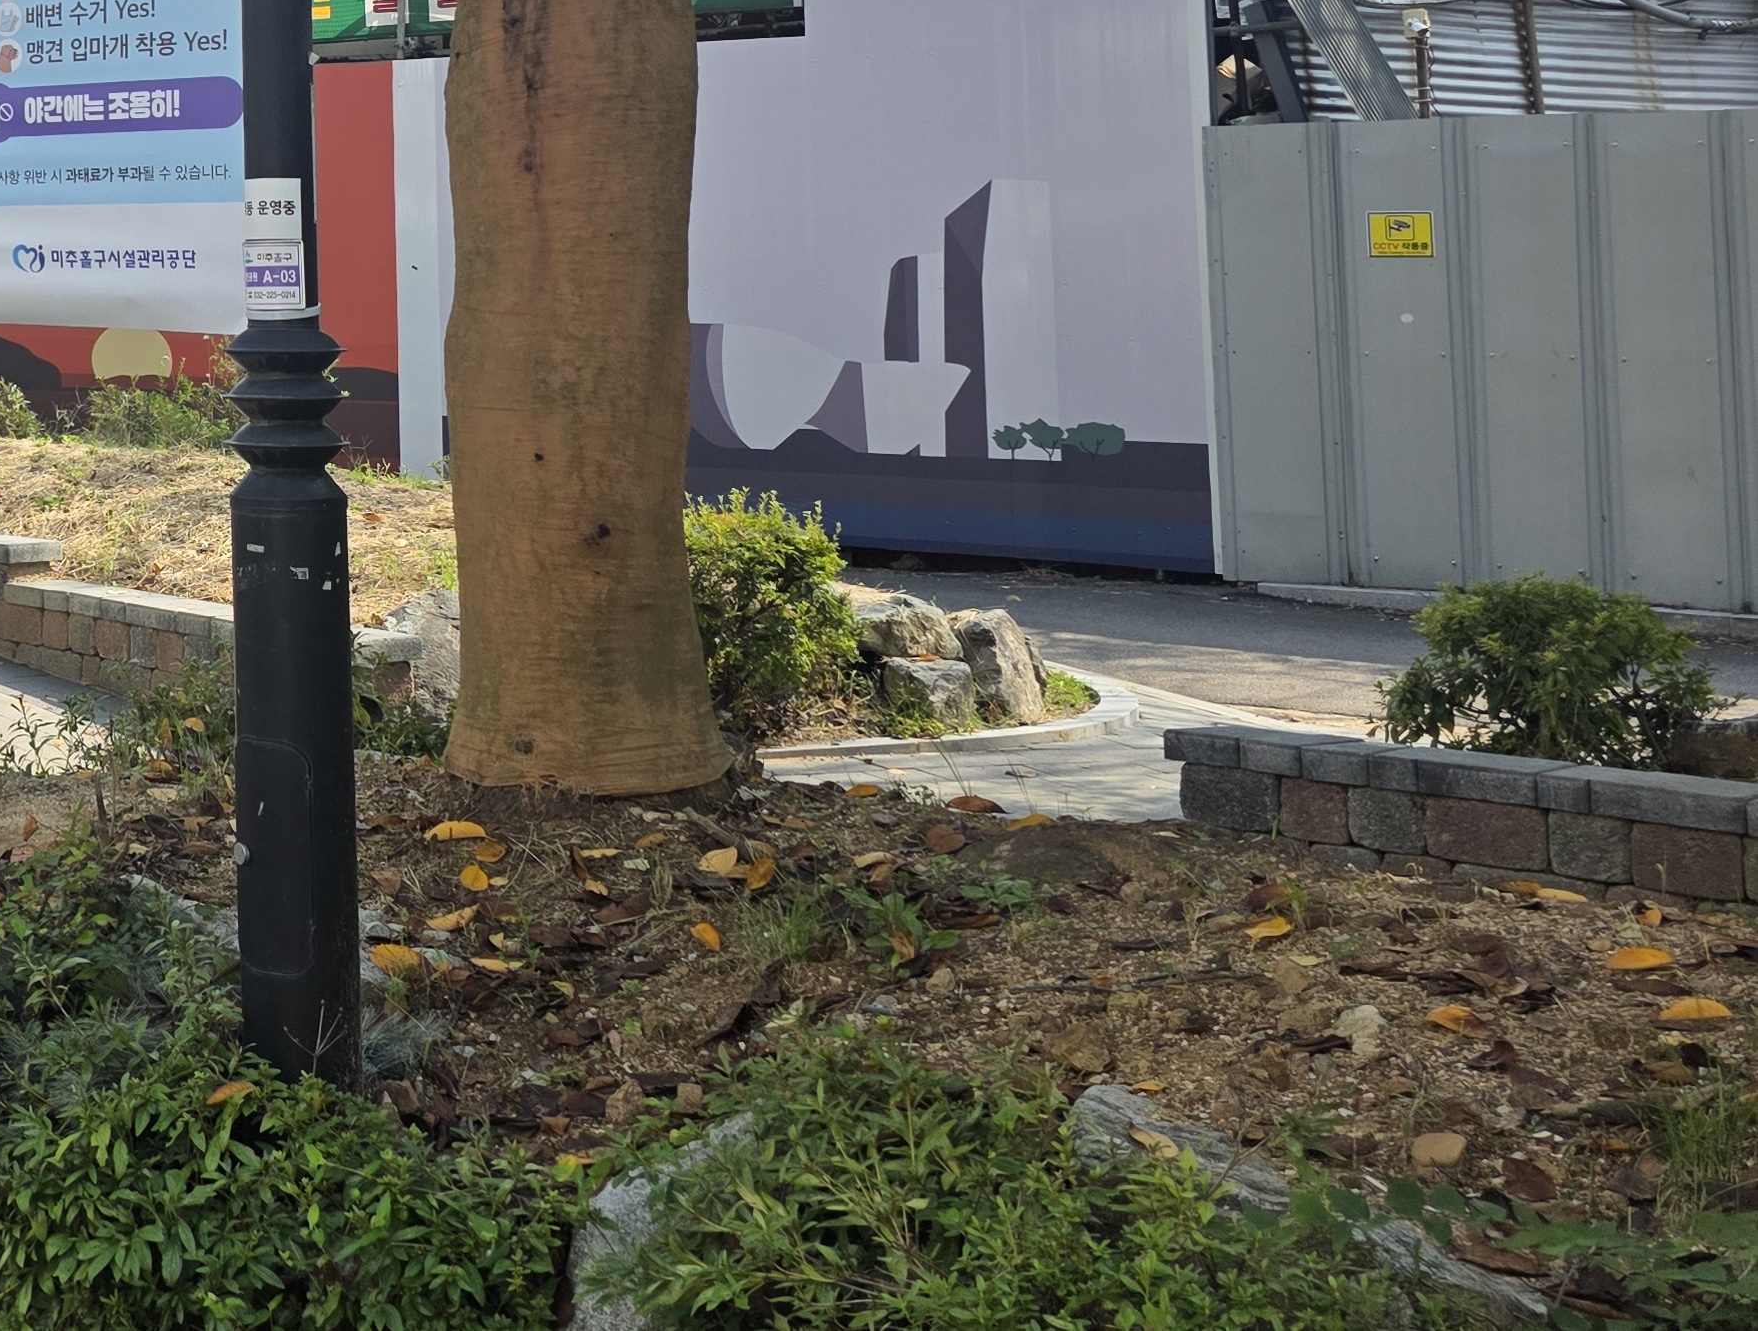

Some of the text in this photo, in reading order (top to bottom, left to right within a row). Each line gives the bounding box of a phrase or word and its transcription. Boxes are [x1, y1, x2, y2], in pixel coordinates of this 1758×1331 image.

[25, 2, 63, 29] 배변
[26, 28, 228, 65] 맹견 입마개 착용 Yes!
[24, 89, 180, 125] 야간에는 조용히!
[23, 168, 47, 186] 위반
[50, 168, 63, 184] 시
[65, 166, 115, 184] 과태료가
[117, 165, 155, 183] 부과될
[158, 165, 172, 181] 수
[175, 163, 232, 182] 있습니다.
[256, 199, 297, 217] 운영중
[1372, 242, 1400, 251] CCTV
[50, 249, 197, 270] 미추홀구시설관리공단
[262, 269, 298, 284] A-03
